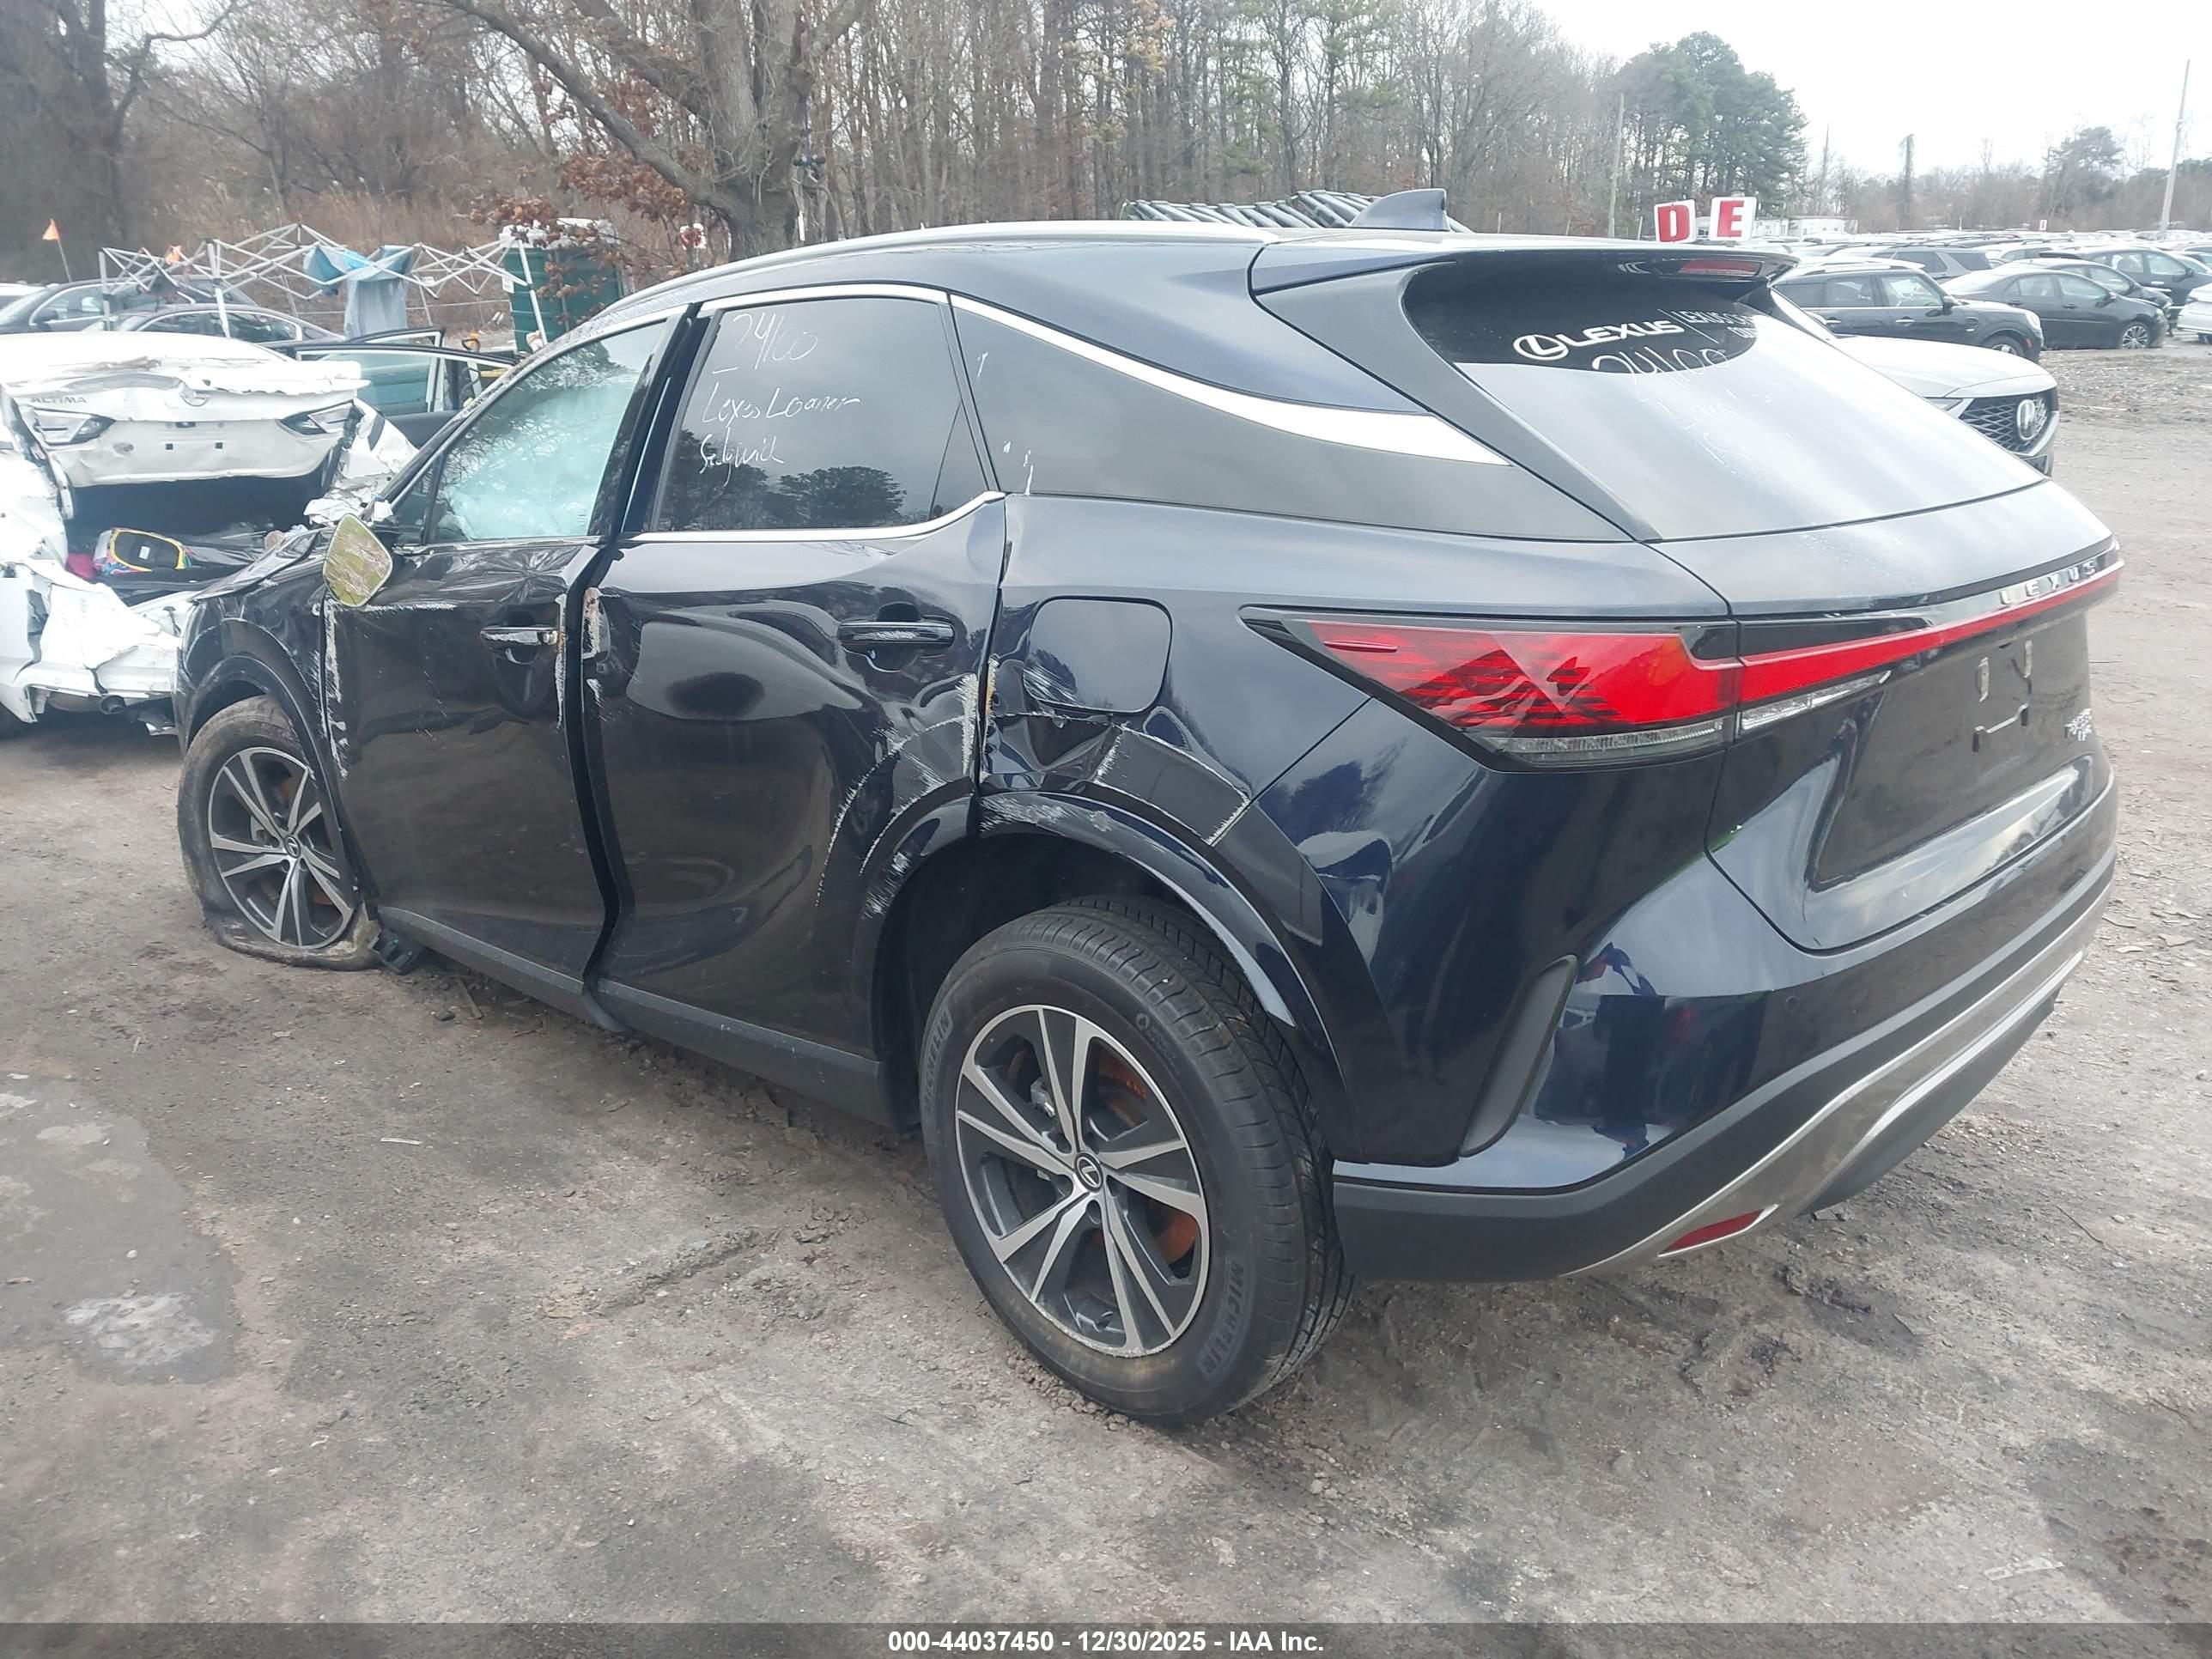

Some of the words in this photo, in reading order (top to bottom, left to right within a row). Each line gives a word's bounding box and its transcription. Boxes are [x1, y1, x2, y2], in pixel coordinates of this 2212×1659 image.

[1657, 204, 1690, 243] D
[1717, 200, 1745, 238] E
[1556, 320, 1686, 347] LEXUS
[2000, 560, 2097, 606] LEXUS
[1202, 1261, 1245, 1374] MICHELIN
